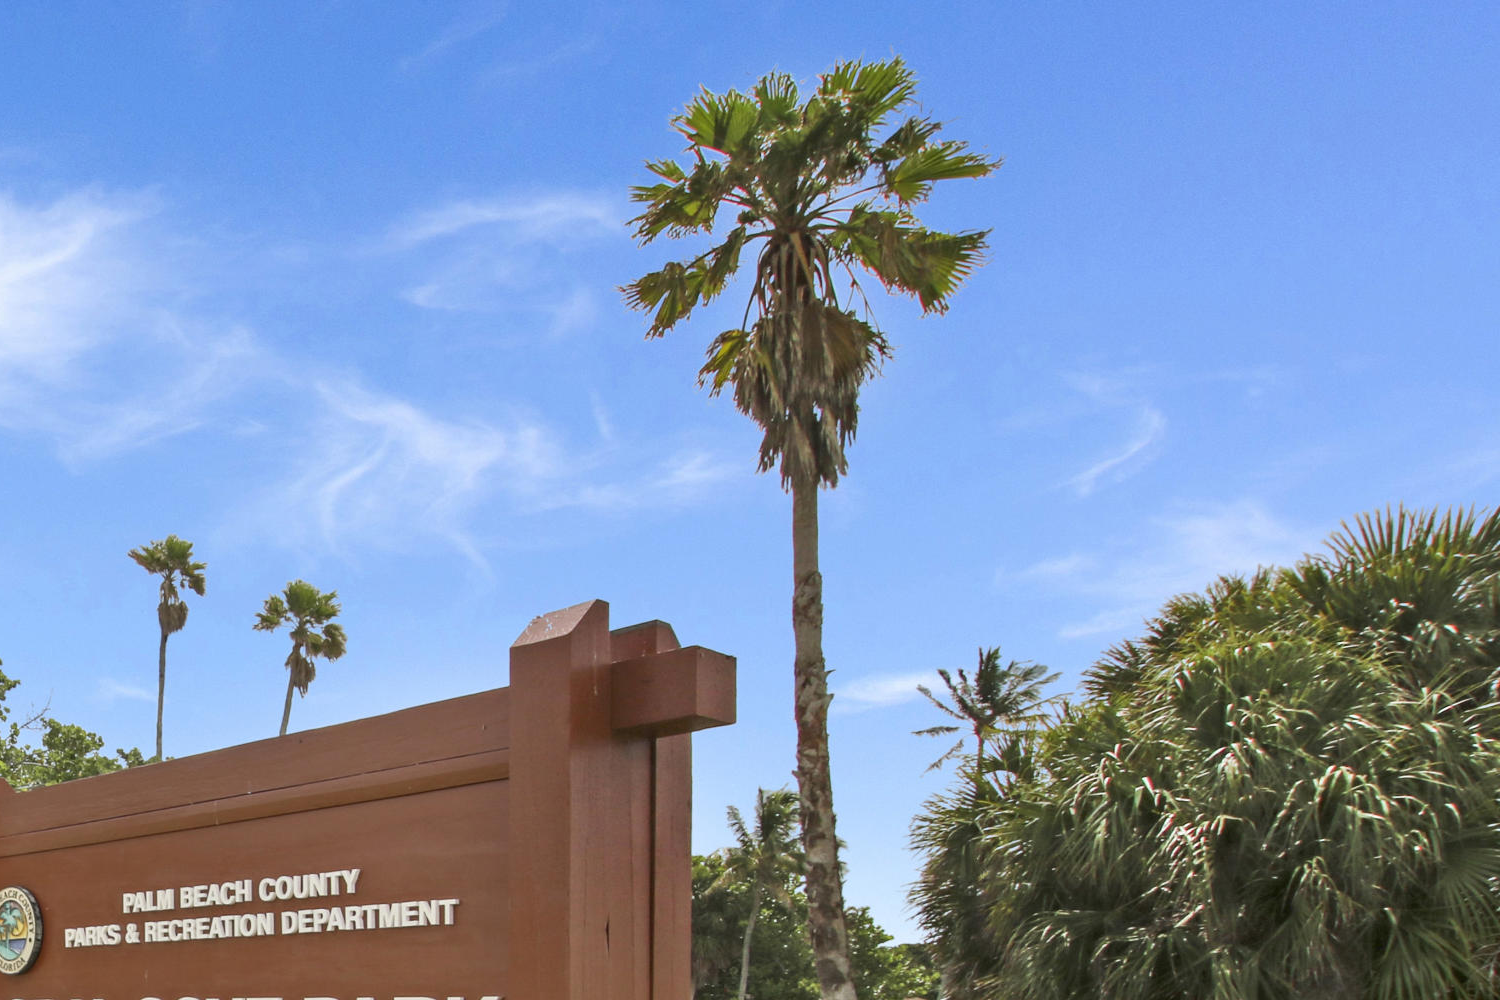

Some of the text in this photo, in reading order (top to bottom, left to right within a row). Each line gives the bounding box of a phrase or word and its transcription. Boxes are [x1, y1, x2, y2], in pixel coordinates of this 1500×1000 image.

[18, 894, 35, 934] COUNTY
[122, 868, 361, 914] PALM BEACH COUNTY
[64, 898, 460, 948] PARKS & RECREATION DEPARTMENT
